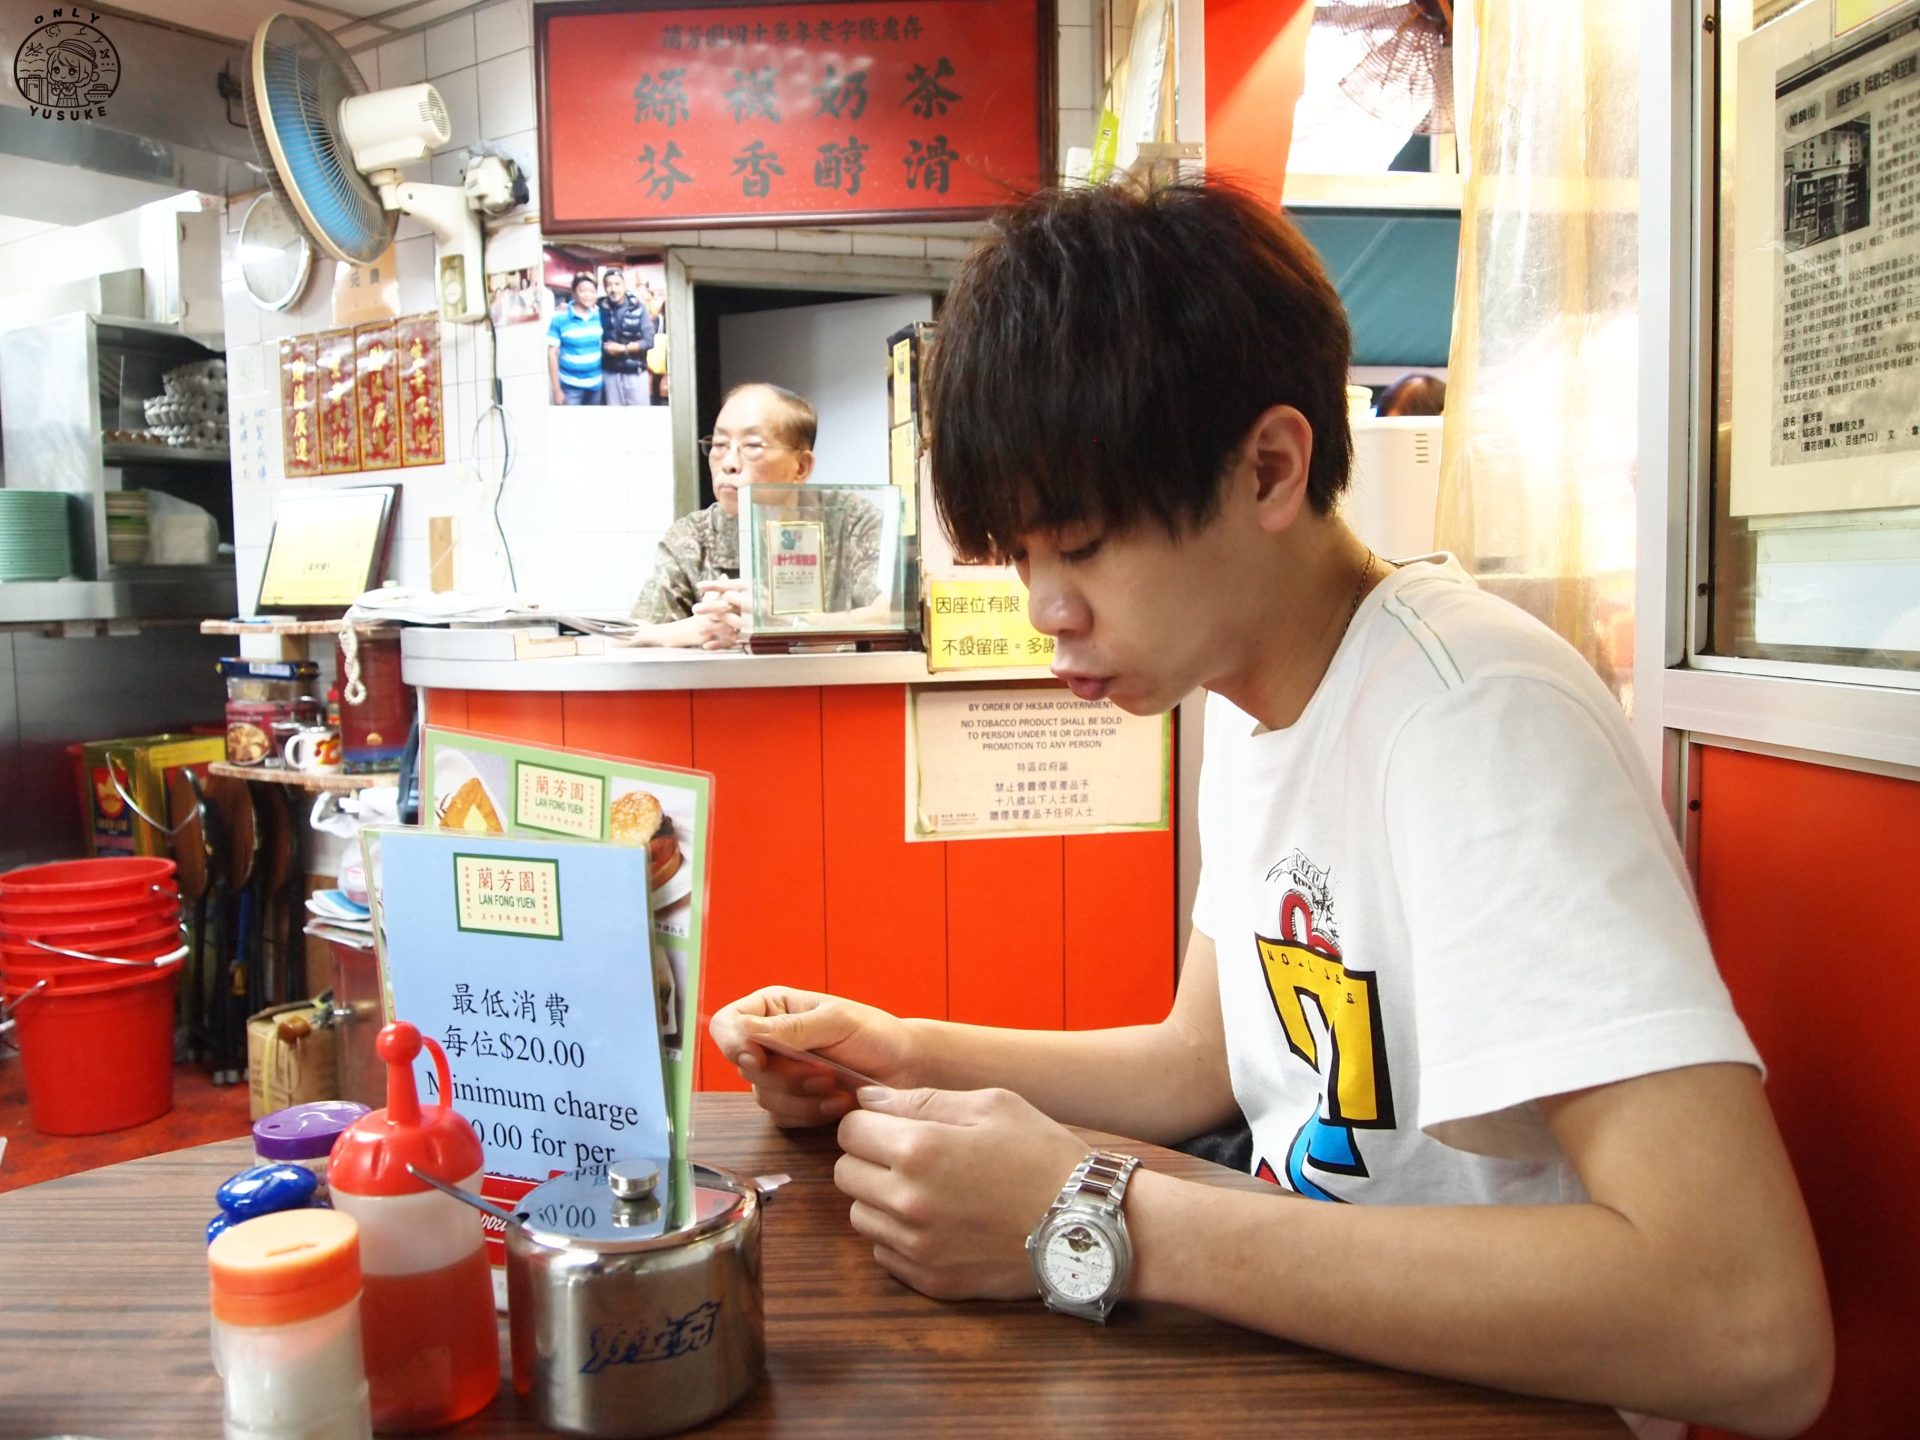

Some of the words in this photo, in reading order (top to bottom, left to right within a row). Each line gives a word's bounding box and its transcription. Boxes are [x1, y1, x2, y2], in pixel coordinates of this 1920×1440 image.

[633, 56, 963, 128] 絲襪奶茶
[636, 134, 960, 201] 芬香醇滑
[935, 595, 1021, 615] 因座位有限
[968, 703, 979, 712] BY
[982, 702, 1011, 712] ORDER
[1013, 701, 1024, 711] OF
[1026, 701, 1054, 711] HKSAR
[961, 720, 975, 728] NO
[977, 719, 1017, 728] TOBACCO
[1019, 718, 1058, 727] PRODUCT
[1060, 717, 1086, 726] SHALL
[1088, 717, 1098, 725] BE
[1100, 716, 1122, 725] SOLD
[967, 731, 979, 740] TO
[981, 730, 1015, 739] PERSON
[1017, 729, 1047, 739] UNDER
[1049, 729, 1058, 738] 18
[1059, 729, 1071, 738] OR
[1073, 728, 1099, 738] GIVEN
[1100, 727, 1116, 737] FOR
[982, 742, 1034, 751] PROMOTION
[1036, 741, 1047, 750] TO
[1049, 741, 1066, 750] ANY
[1068, 740, 1102, 749] PERSON
[535, 775, 584, 802] 蘭芳園
[535, 797, 547, 808] LAN
[548, 799, 566, 812] FONG
[567, 803, 584, 815] YUEN
[477, 867, 536, 894] 蘭芳園
[478, 894, 493, 906] LAN
[494, 895, 515, 908] FONG
[516, 896, 536, 909] YUEN
[450, 983, 570, 1029] 最低消費
[441, 1024, 586, 1069] 每位$20.00
[554, 1090, 640, 1131] charge
[530, 1127, 567, 1158] for
[574, 1142, 616, 1168] per
